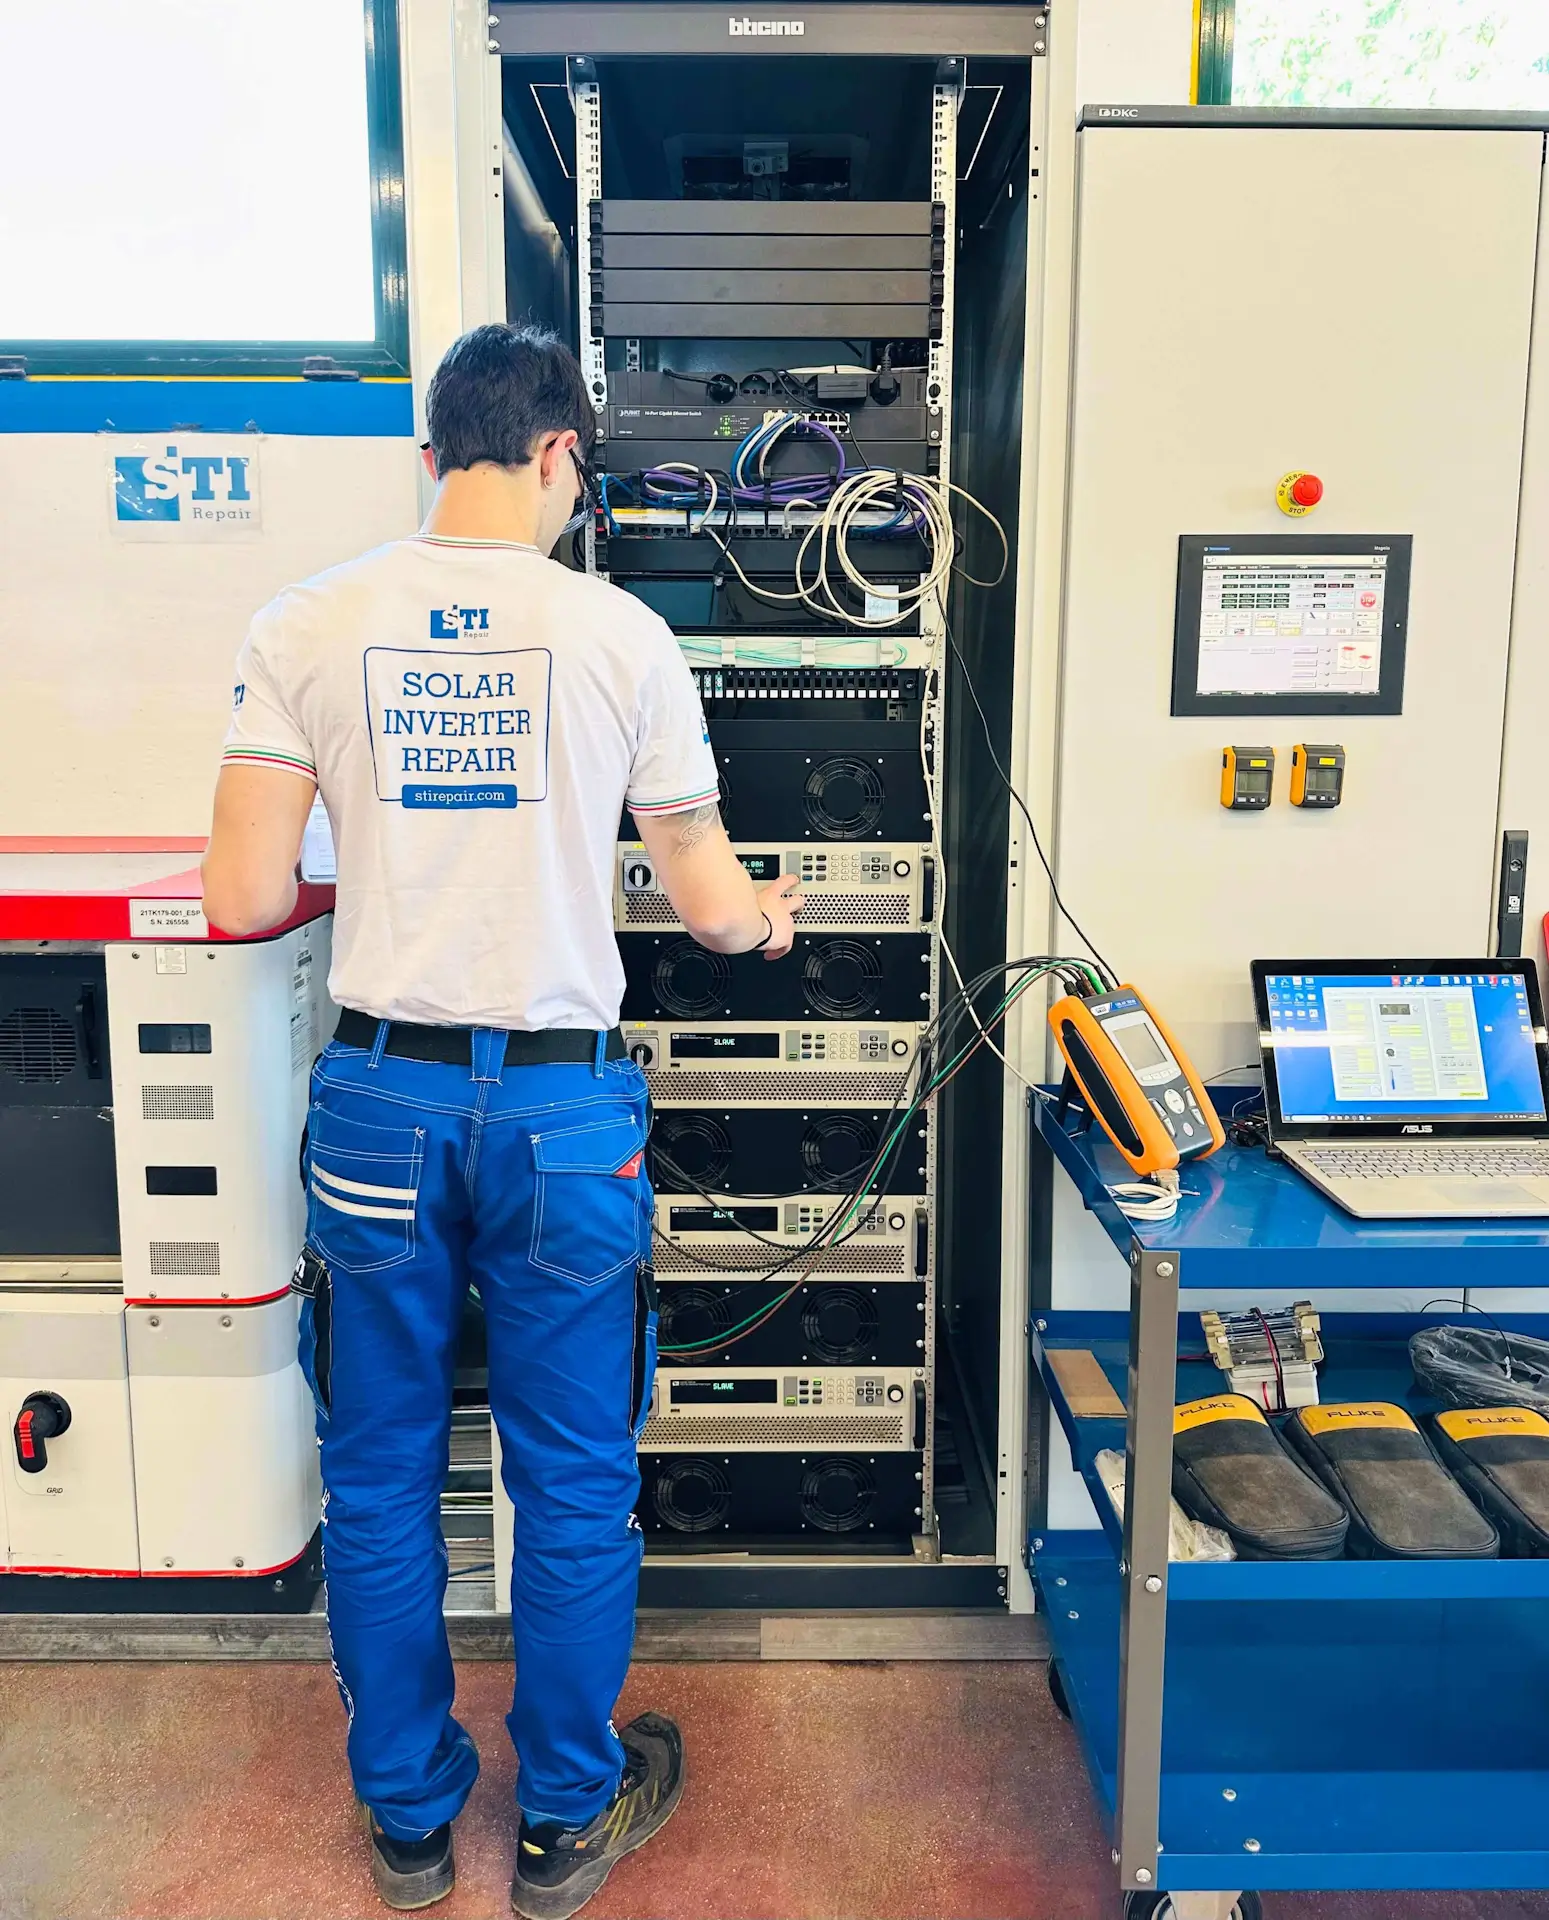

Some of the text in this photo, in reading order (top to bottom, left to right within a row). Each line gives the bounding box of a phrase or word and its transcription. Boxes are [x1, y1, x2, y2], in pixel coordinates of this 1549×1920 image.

[729, 17, 804, 36] bticino
[1111, 108, 1138, 117] DKC
[142, 446, 251, 501] STI
[193, 507, 251, 522] Repair
[441, 604, 490, 630] STI
[463, 631, 489, 640] Repair
[402, 671, 516, 699] SOLAR
[383, 708, 532, 737] INVERTER
[401, 747, 517, 773] REPAIR
[414, 790, 506, 805] stirepair.com
[713, 1038, 736, 1046] SLAVE
[1400, 1124, 1433, 1134] ASUS
[712, 1382, 734, 1390] SLAVE
[1179, 1402, 1236, 1417] FLUKE
[1326, 1410, 1386, 1418] FLUKE
[1465, 1416, 1526, 1424] FLUKE
